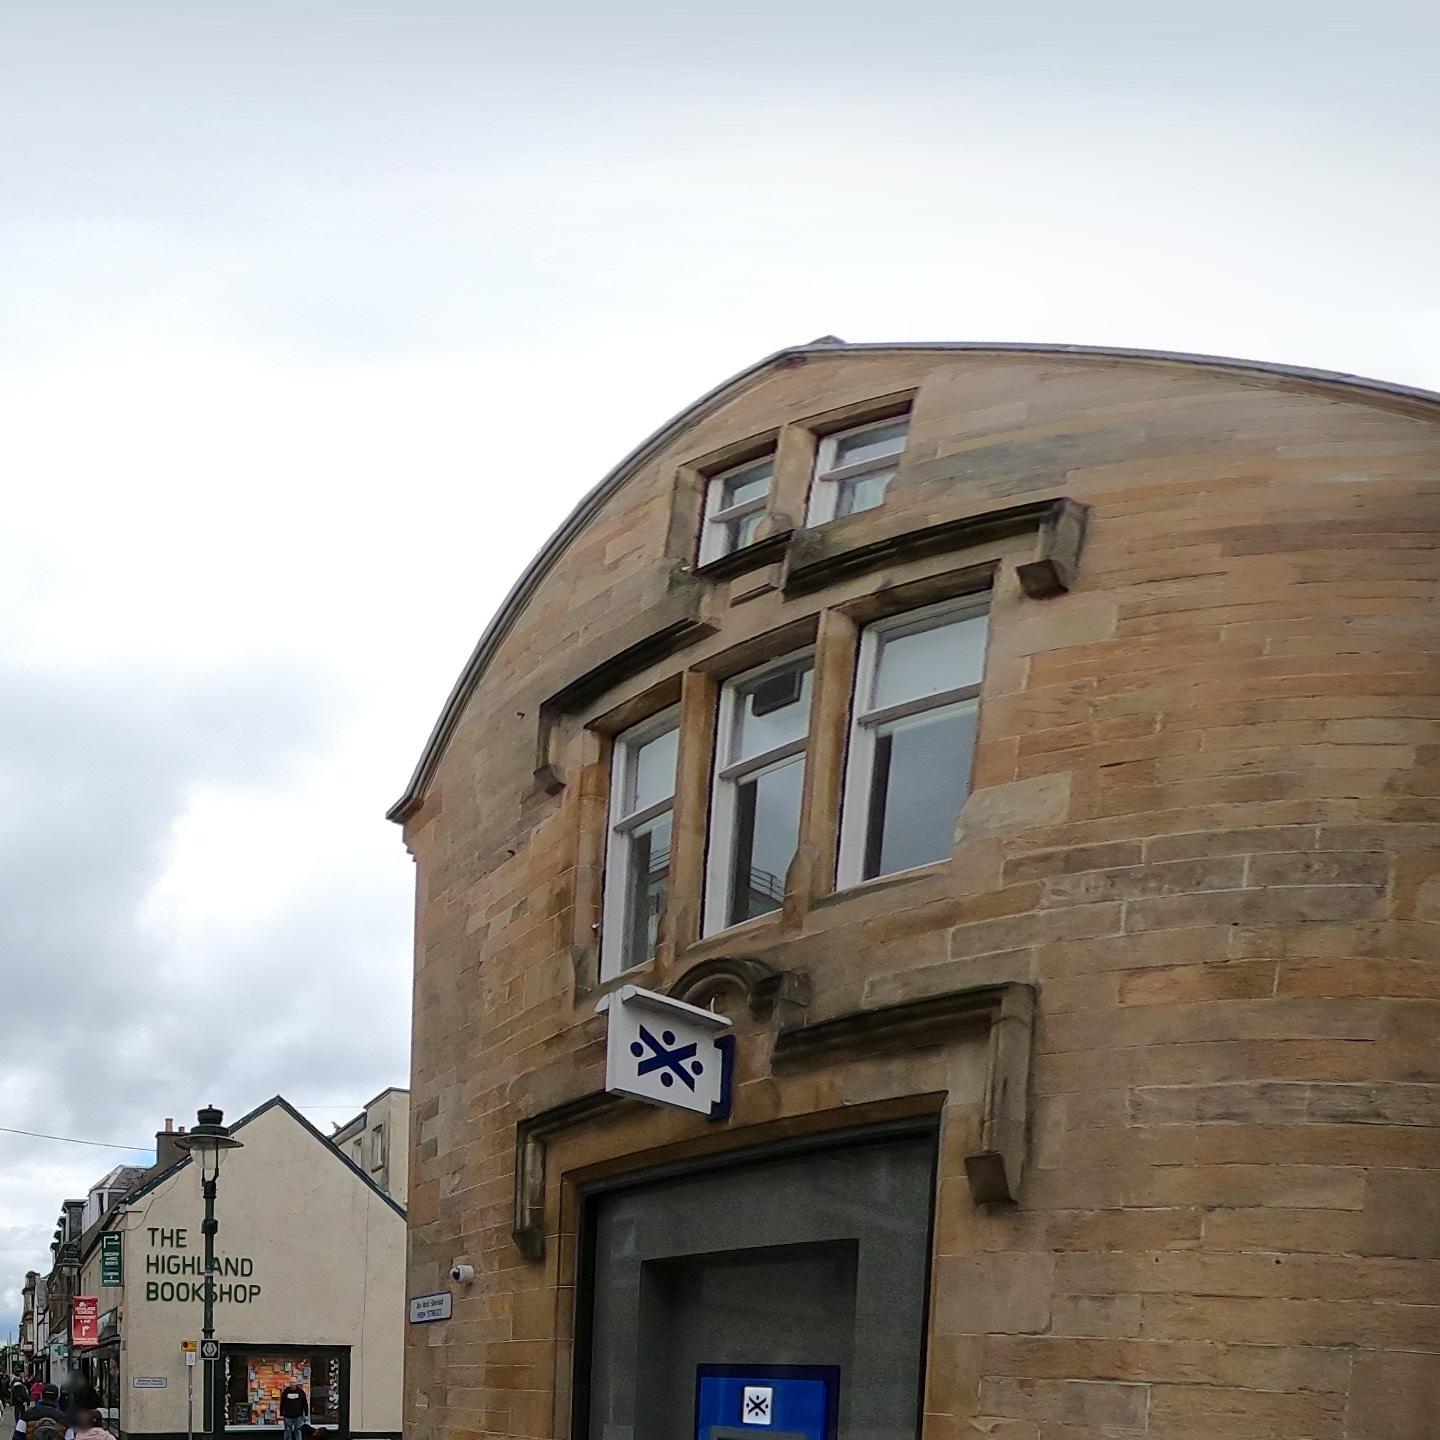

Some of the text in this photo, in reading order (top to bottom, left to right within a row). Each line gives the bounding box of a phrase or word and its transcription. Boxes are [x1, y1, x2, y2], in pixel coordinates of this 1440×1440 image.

[147, 1227, 187, 1248] THE
[146, 1254, 254, 1278] HIGHLAND
[146, 1281, 261, 1304] BOOKSHOP
